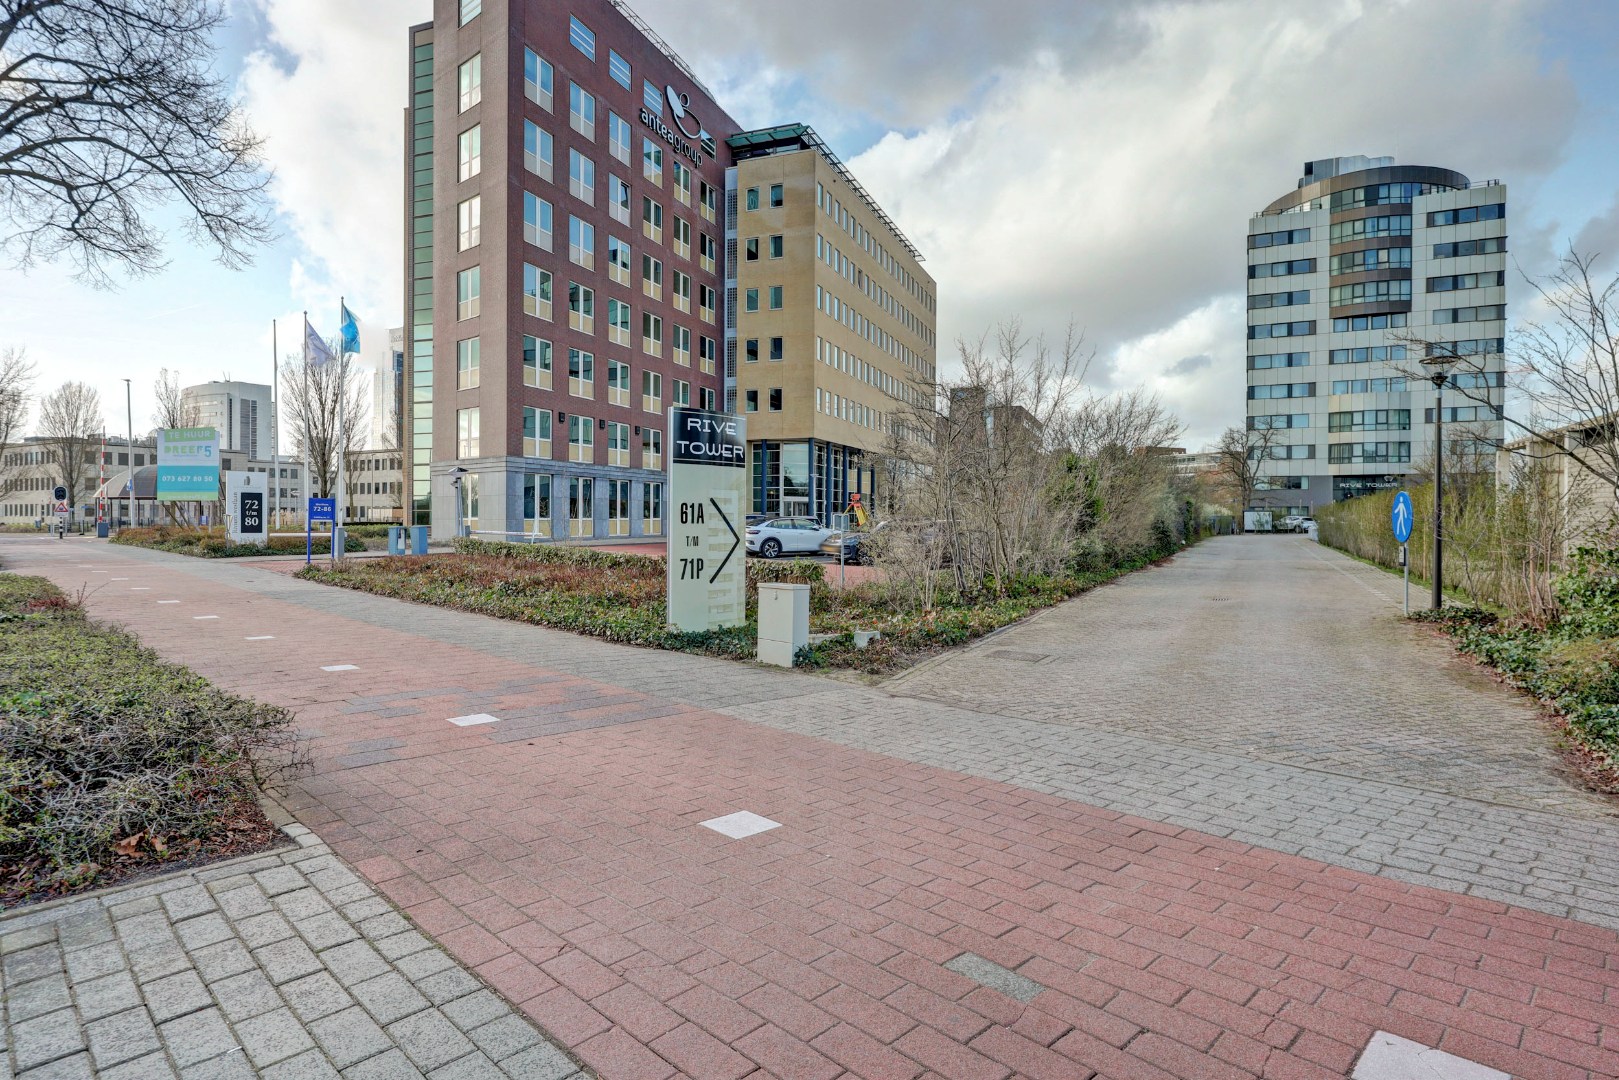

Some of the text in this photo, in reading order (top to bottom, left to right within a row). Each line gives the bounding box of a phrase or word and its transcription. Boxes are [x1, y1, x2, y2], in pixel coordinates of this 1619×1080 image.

[640, 107, 703, 168] anteagroup
[687, 417, 737, 436] RIVE
[676, 440, 744, 459] TOWER
[244, 500, 259, 509] 72
[680, 503, 705, 525] 61A
[244, 516, 259, 526] 80
[686, 536, 699, 548] T/M
[680, 559, 704, 581] 71P
